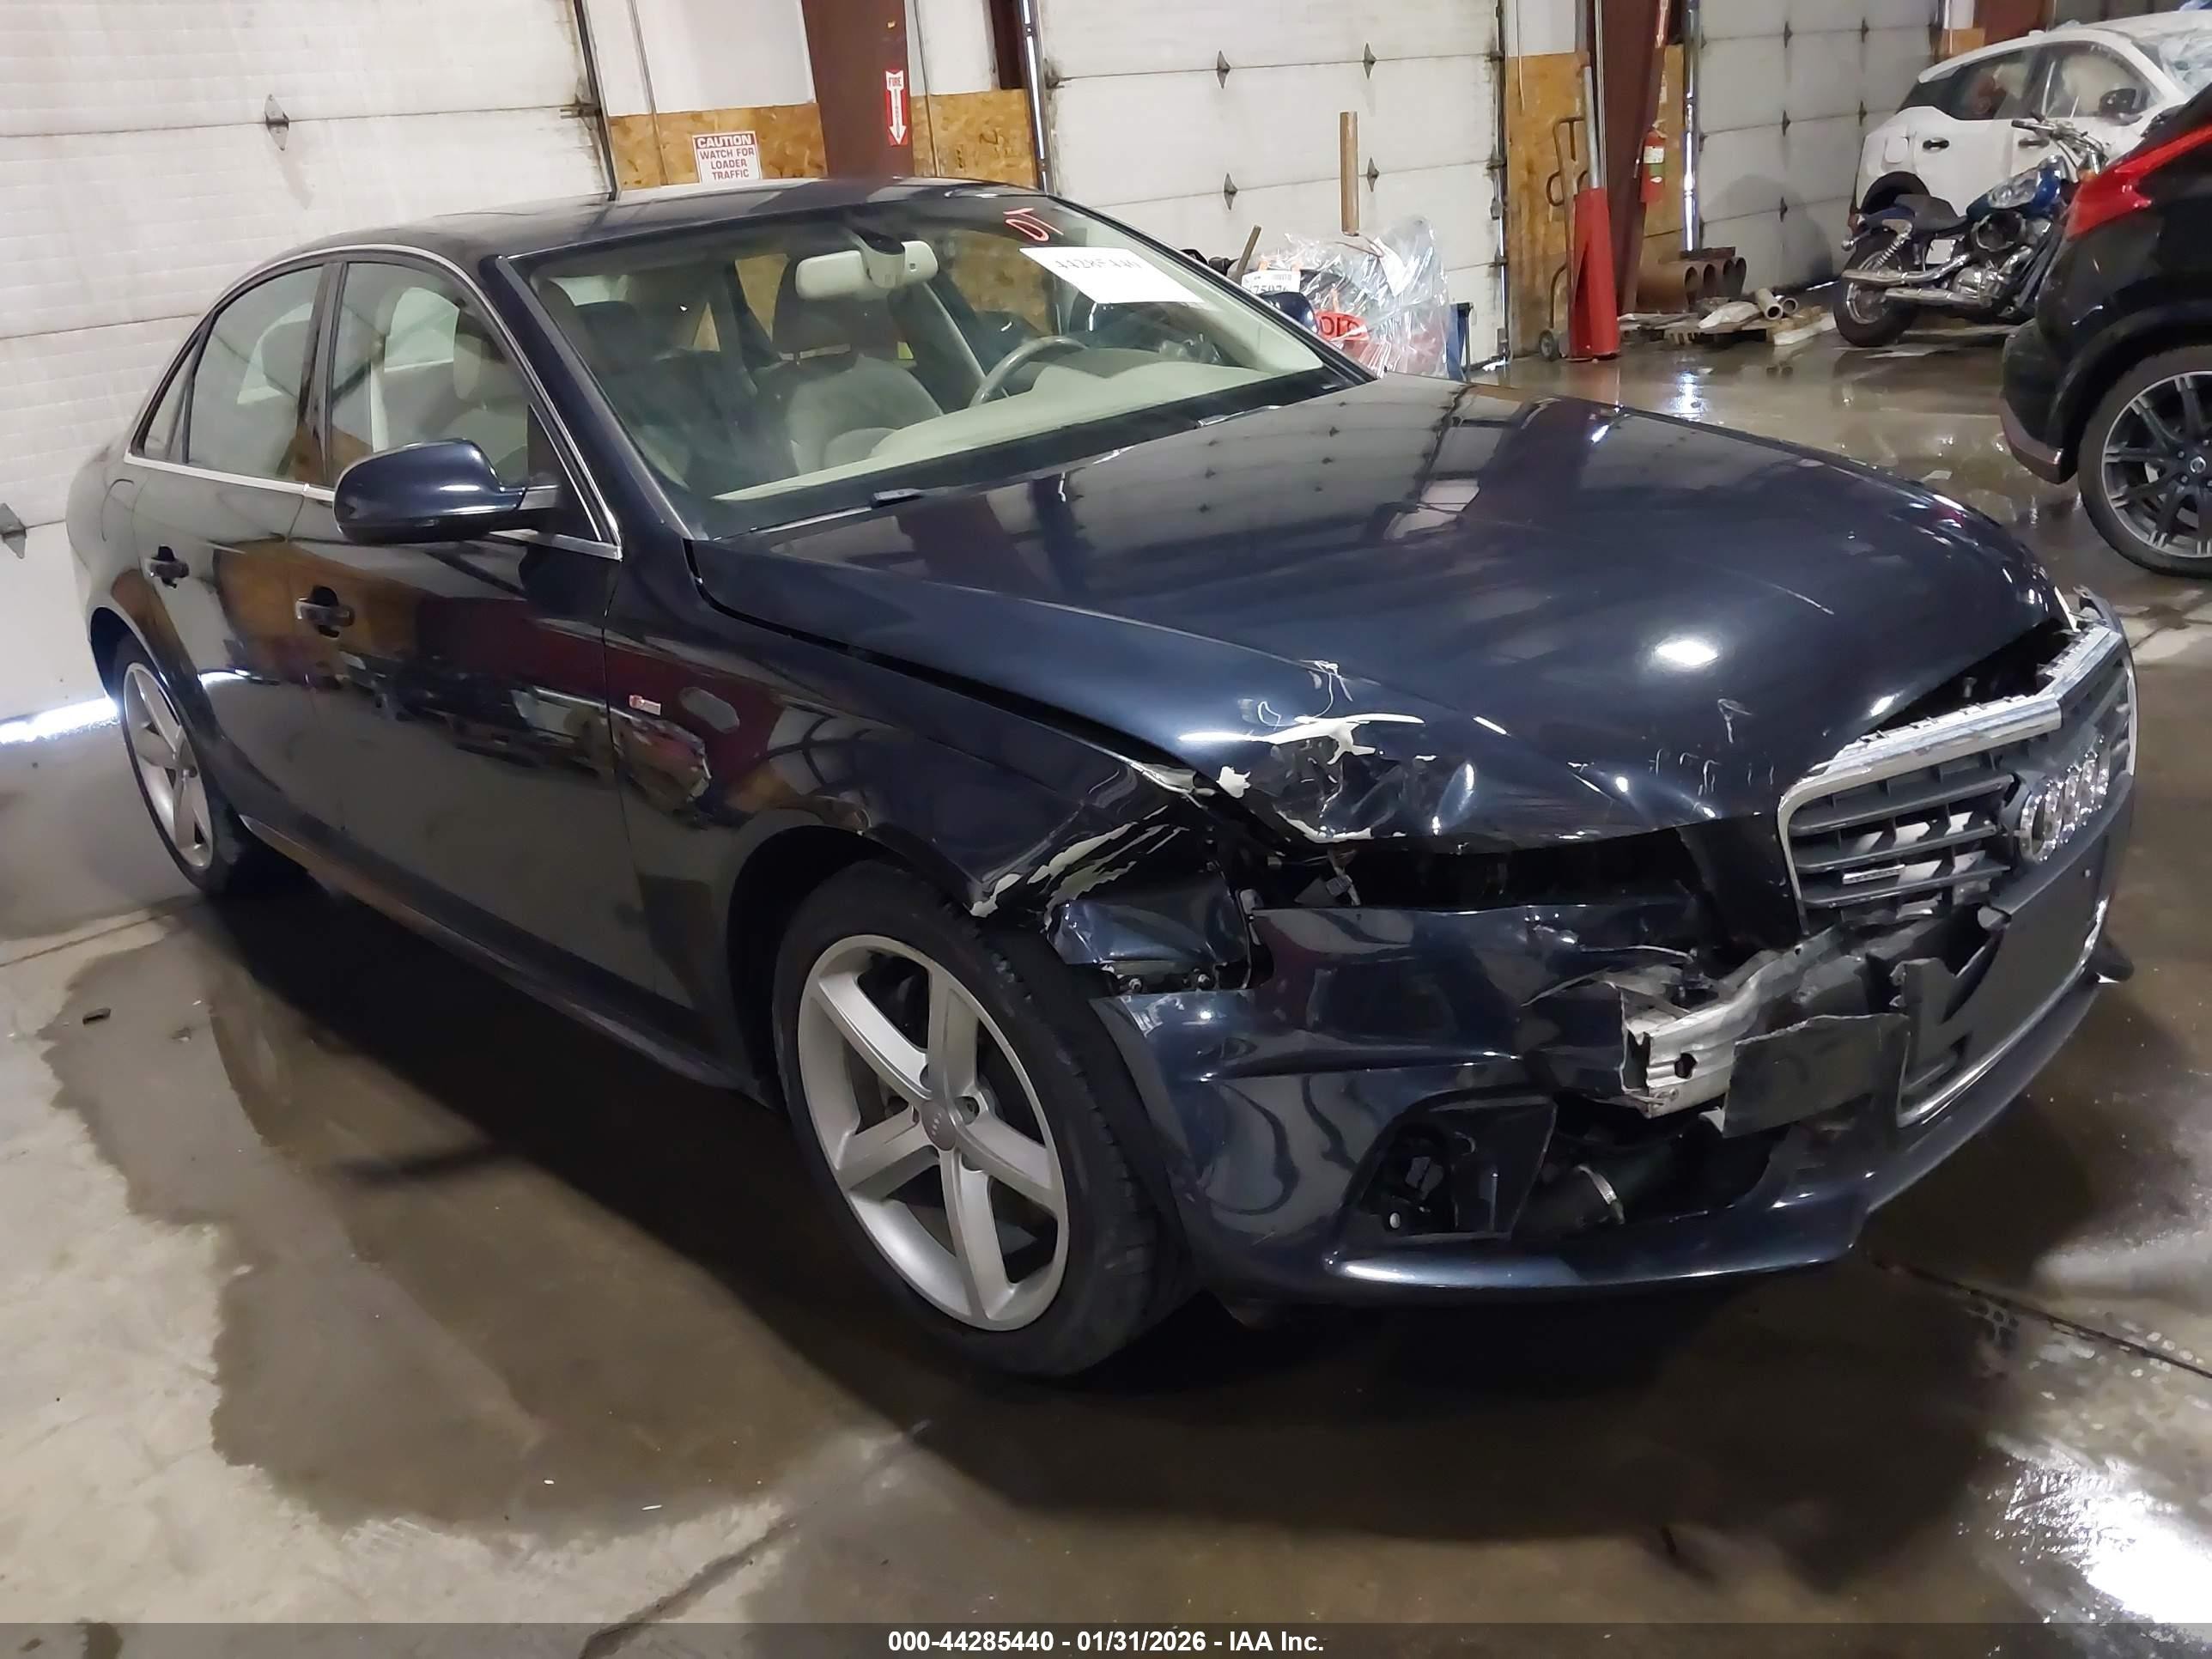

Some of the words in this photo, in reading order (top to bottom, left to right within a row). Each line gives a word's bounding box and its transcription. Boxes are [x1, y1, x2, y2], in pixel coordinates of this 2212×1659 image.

[888, 76, 902, 87] FIRE
[696, 134, 752, 149] CAUTION
[699, 149, 733, 160] WATCH
[736, 147, 755, 157] FOR
[710, 159, 748, 170] LOADER
[712, 169, 750, 180] TRAFFIC
